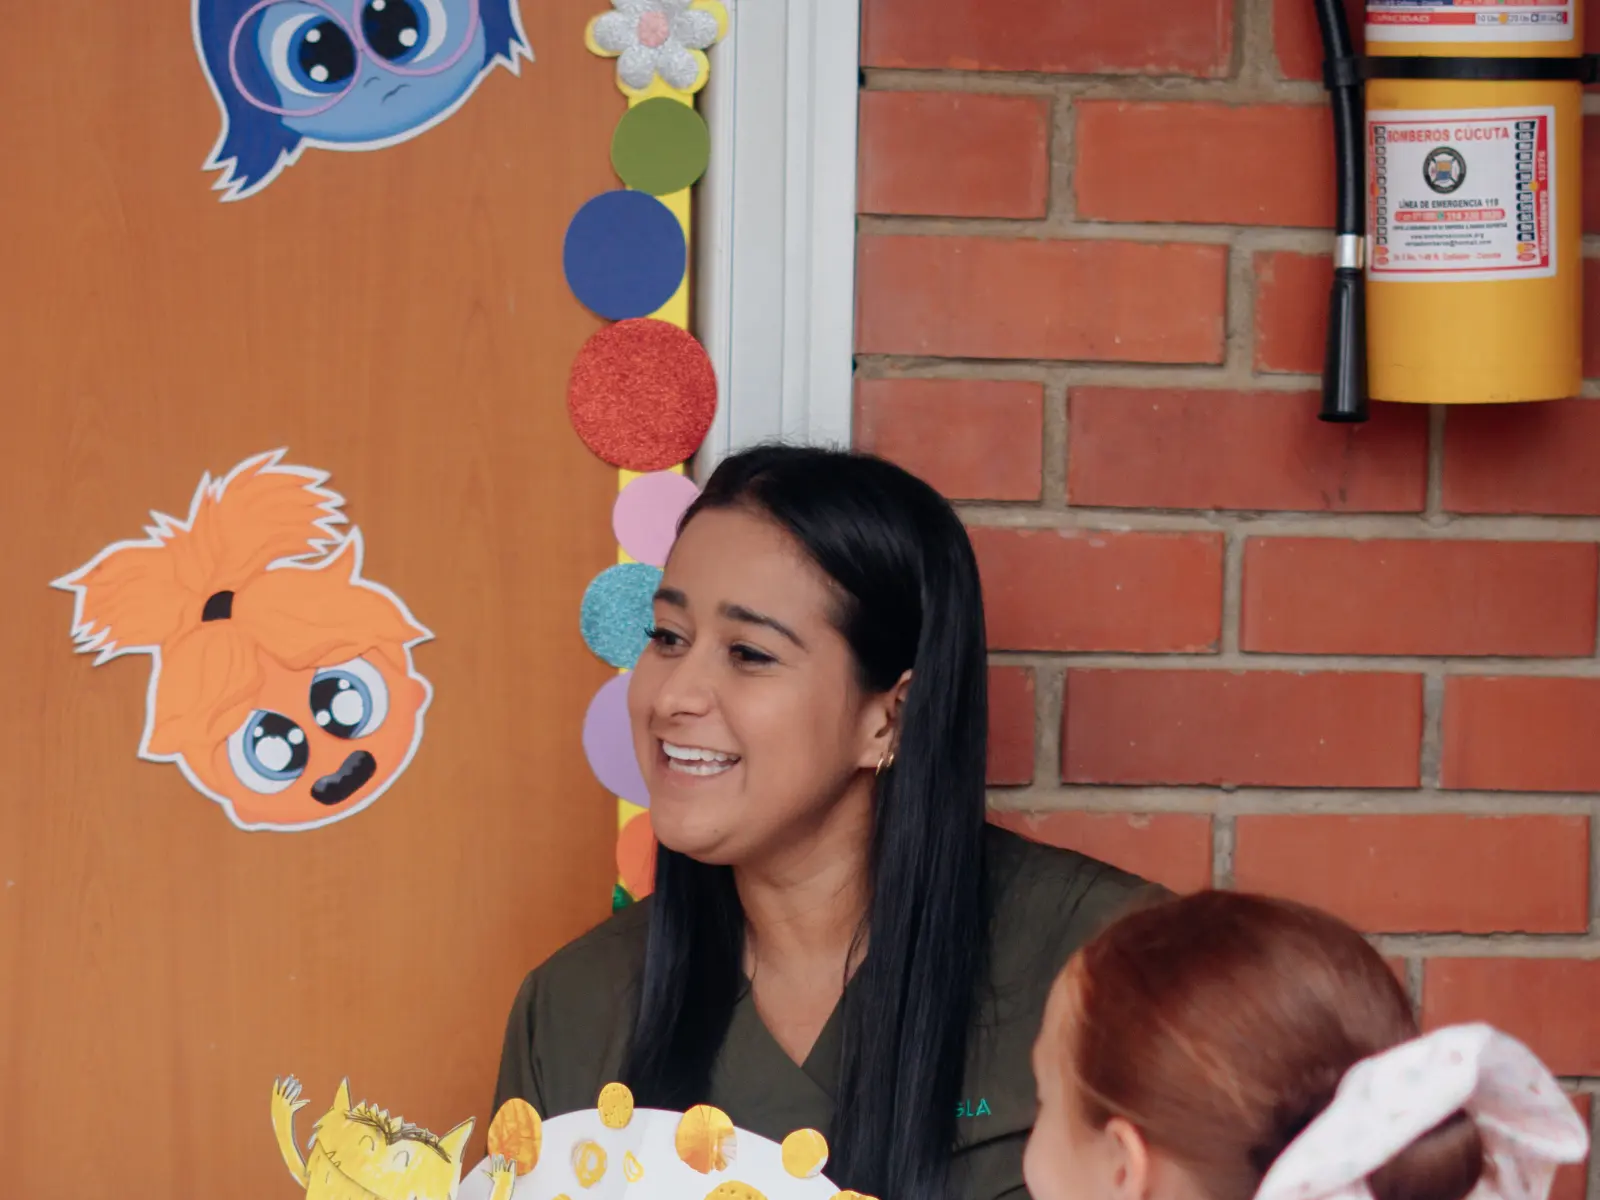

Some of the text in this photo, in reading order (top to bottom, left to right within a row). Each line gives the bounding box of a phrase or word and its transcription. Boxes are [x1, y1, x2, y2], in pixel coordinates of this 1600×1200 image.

[1387, 129, 1450, 142] BOMBEROS
[1420, 200, 1429, 208] DE
[1431, 198, 1482, 208] EMERGENCIA
